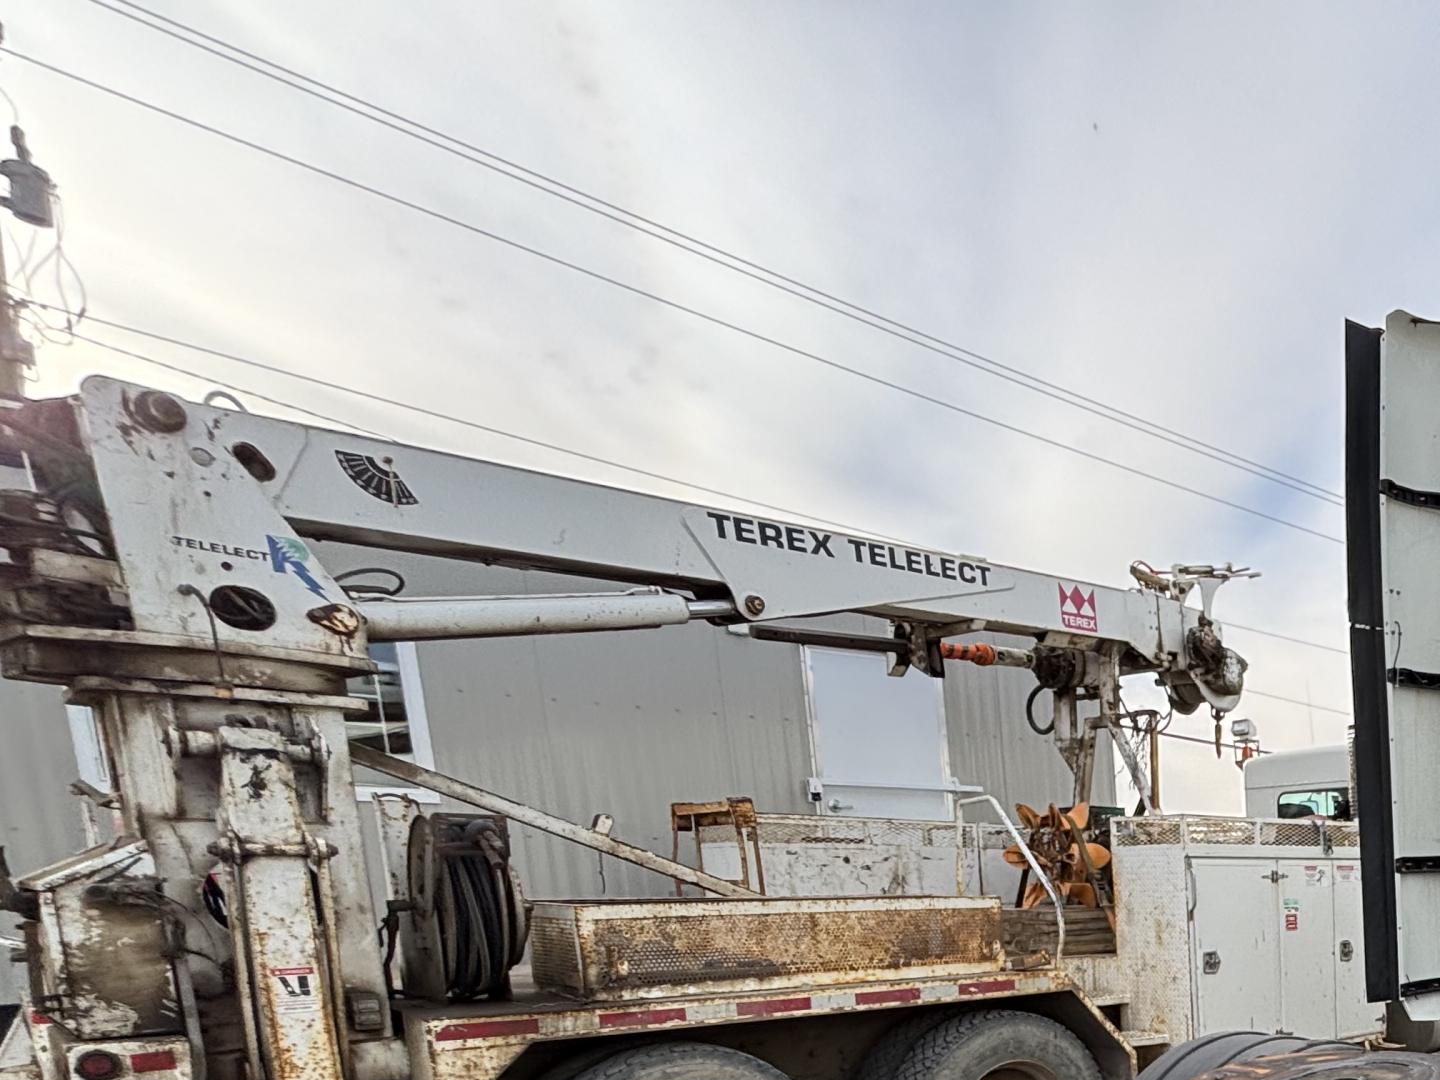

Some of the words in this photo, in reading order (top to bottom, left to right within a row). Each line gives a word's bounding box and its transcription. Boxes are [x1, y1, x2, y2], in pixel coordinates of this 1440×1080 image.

[172, 535, 270, 562] TELELECT
[707, 511, 835, 558] TEREX
[848, 539, 991, 586] TELELECT
[1063, 614, 1097, 631] TEREX
